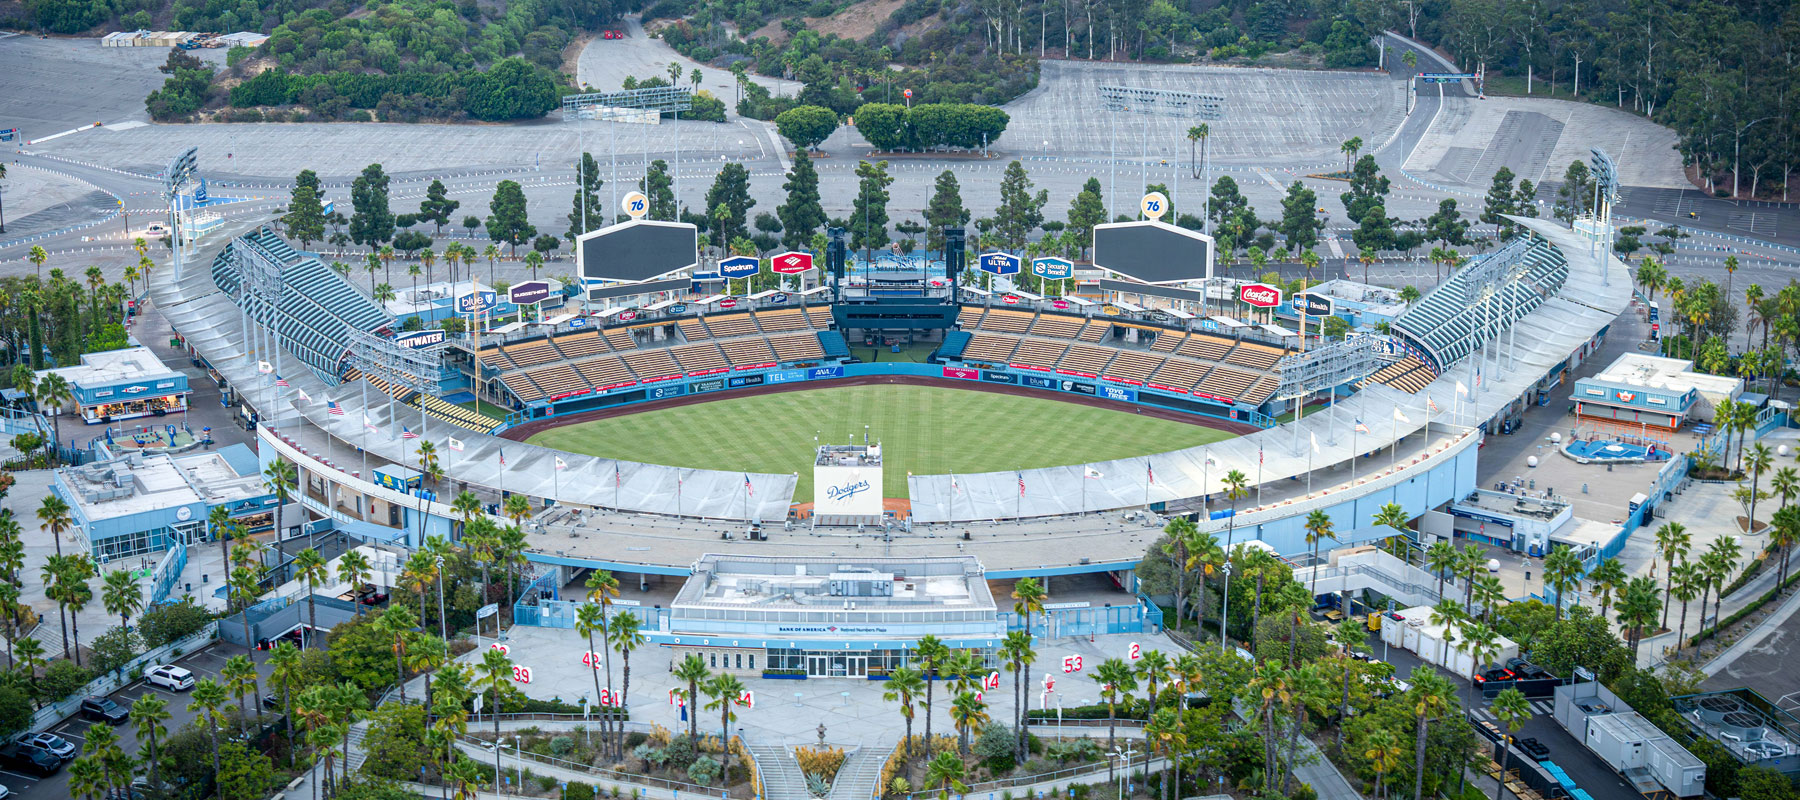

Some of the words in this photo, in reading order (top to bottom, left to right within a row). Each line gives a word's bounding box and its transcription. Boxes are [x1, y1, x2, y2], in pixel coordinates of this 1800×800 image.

[631, 200, 644, 211] 76
[1147, 200, 1160, 212] 76
[723, 263, 754, 273] Spectrum
[988, 259, 1011, 267] ULTRA
[1047, 262, 1069, 271] Security
[1047, 268, 1066, 276] Benefit
[1243, 288, 1276, 304] Coca-Cola
[461, 296, 484, 307] blue
[1310, 301, 1328, 311] Health
[1203, 320, 1216, 329] TEL
[768, 373, 785, 382] TEL
[990, 373, 1009, 381] Spectrum
[1030, 377, 1043, 386] blue
[1104, 387, 1124, 395] TOYO
[1108, 392, 1128, 400] TIRES
[827, 480, 870, 500] Dodgers
[1131, 644, 1140, 660] 2
[582, 652, 599, 669] 42
[1064, 656, 1083, 673] 53
[512, 666, 529, 684] 39
[984, 674, 999, 691] 14
